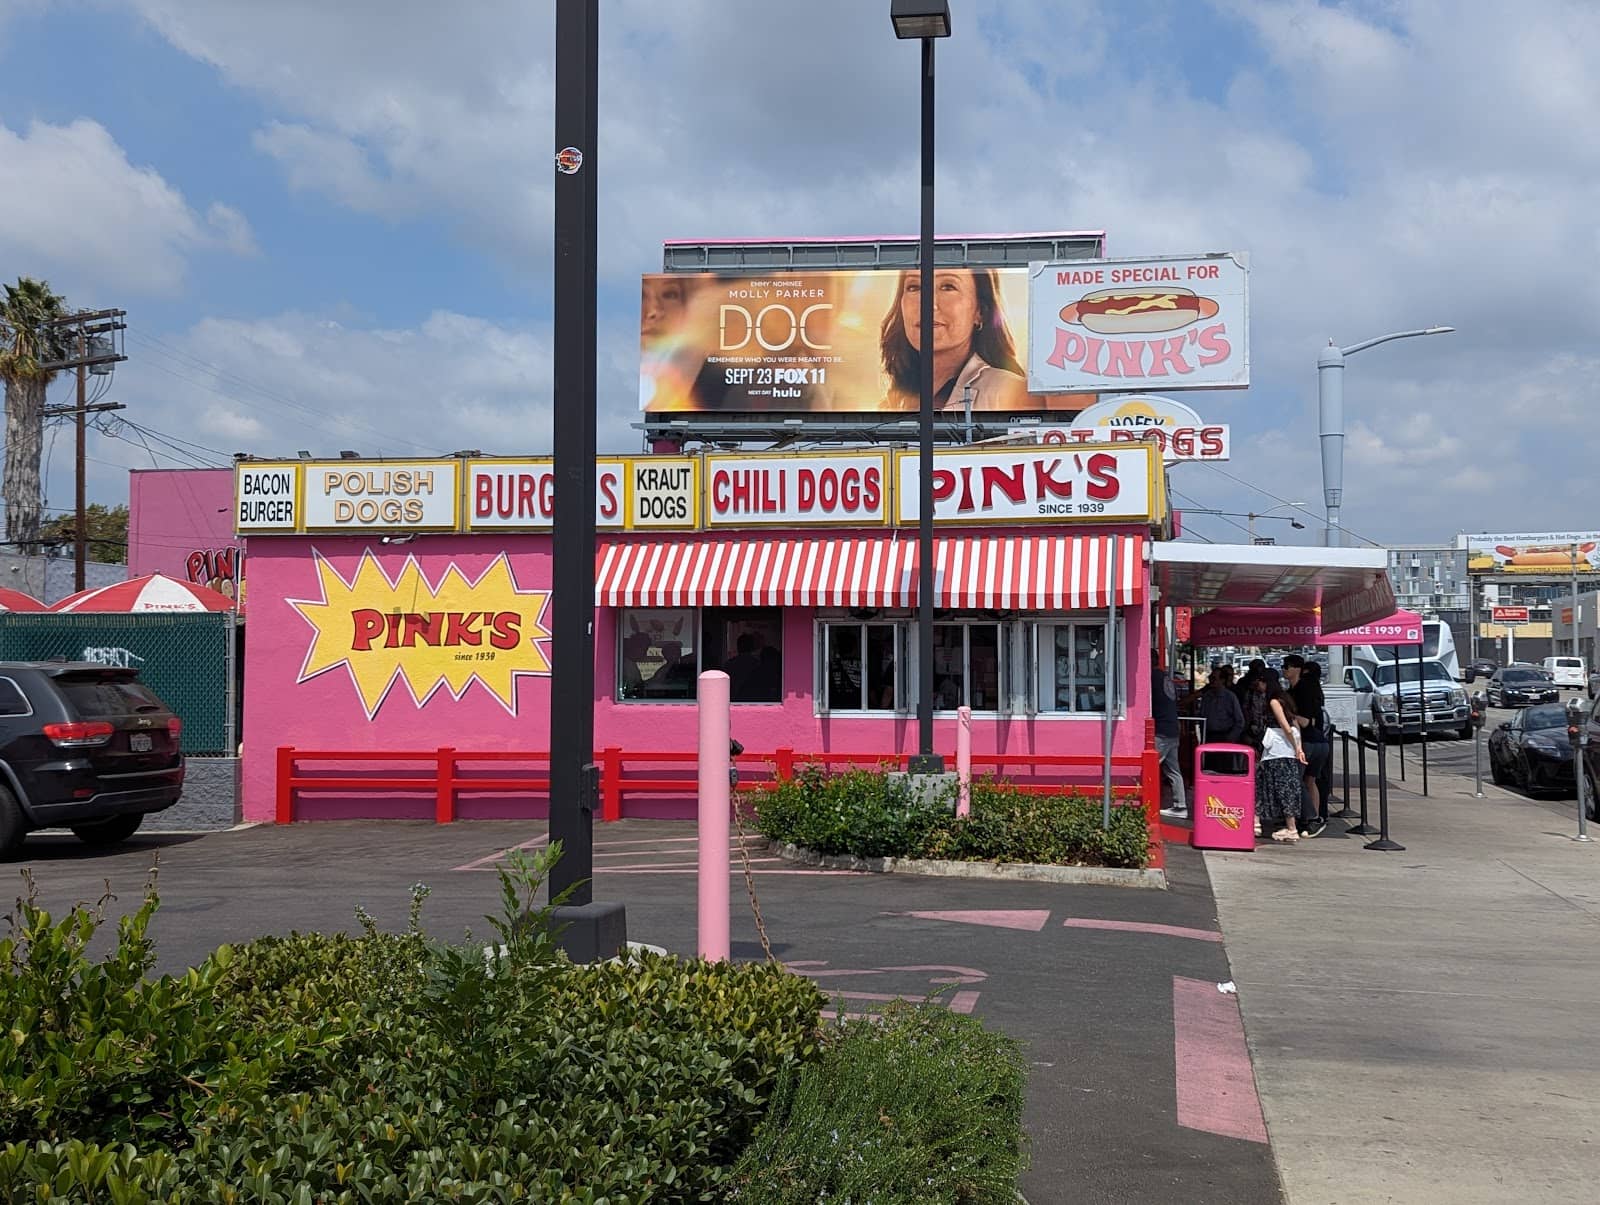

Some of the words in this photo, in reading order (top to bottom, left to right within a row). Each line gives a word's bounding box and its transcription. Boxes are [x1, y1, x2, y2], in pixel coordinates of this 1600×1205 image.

[1057, 270, 1104, 285] MADE
[1111, 267, 1181, 283] SPECIAL
[1187, 265, 1219, 280] FOR
[729, 290, 770, 298] MOLLY
[776, 289, 824, 298] PARKER
[719, 303, 833, 351] DOC
[1046, 323, 1231, 378] PINK'S
[725, 368, 754, 384] SEPT
[757, 368, 772, 384] 23
[774, 368, 808, 384] FOX
[810, 368, 825, 384] 11
[773, 387, 801, 398] hulu
[244, 474, 290, 495] BACON
[324, 471, 434, 494] POLISH
[636, 468, 691, 490] KRAUT
[919, 453, 1121, 515] PINK'S
[475, 473, 618, 518] BURGS
[713, 470, 786, 513] CHILI
[798, 467, 881, 513] DOGS
[240, 501, 293, 522] BURGER
[334, 499, 424, 523] DOGS
[640, 496, 687, 519] DOGS
[1038, 504, 1073, 514] SINCE
[1078, 503, 1105, 513] 1939
[351, 608, 522, 651] PINK'S
[1209, 627, 1216, 635] A
[1219, 626, 1290, 635] HOLLYWOOD
[1374, 626, 1402, 635] 1939
[454, 652, 473, 661] since
[1206, 806, 1244, 816] PINK'S
